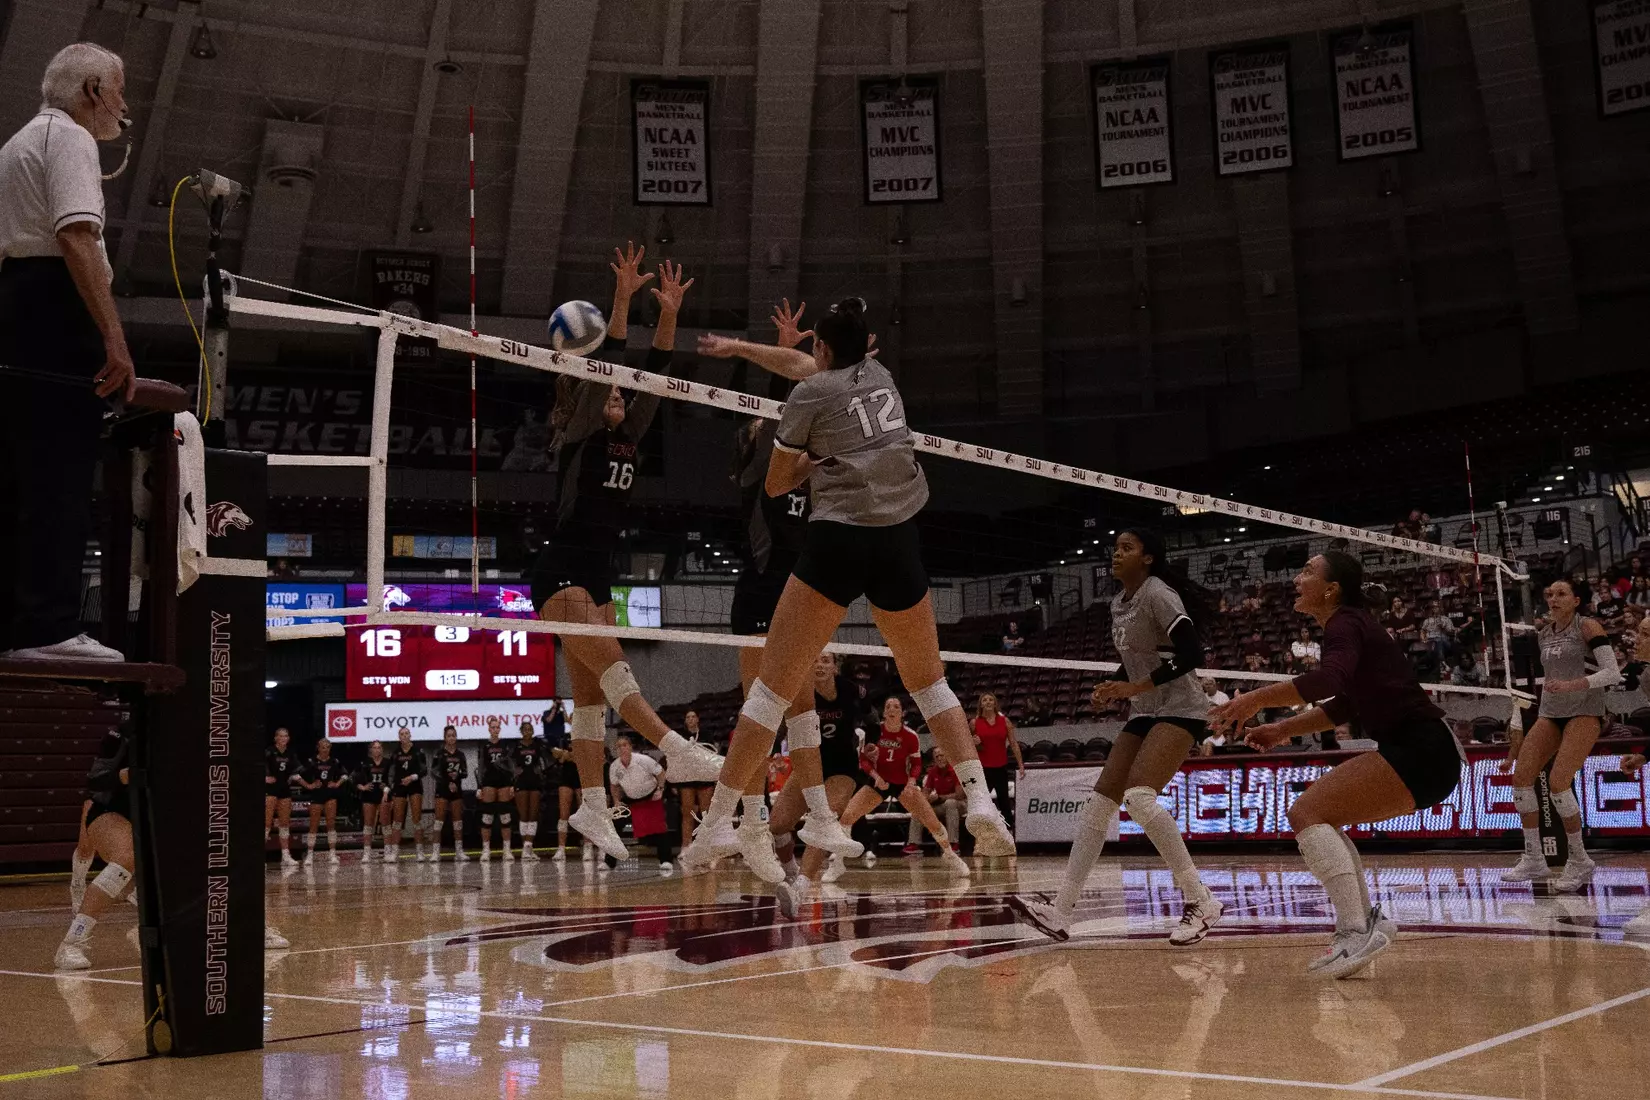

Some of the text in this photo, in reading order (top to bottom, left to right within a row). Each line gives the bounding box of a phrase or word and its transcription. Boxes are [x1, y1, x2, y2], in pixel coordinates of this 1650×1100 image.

[1614, 24, 1650, 47] MV
[1346, 73, 1403, 98] NCAA
[1231, 93, 1271, 114] MVC
[1343, 93, 1410, 111] TOURNAMENT
[868, 110, 932, 119] BASKETBALL
[1105, 107, 1159, 128] NCAA
[1221, 112, 1285, 128] TOURNAMENT
[645, 127, 697, 144] NCAA
[881, 126, 919, 143] MVC
[1101, 127, 1164, 141] TOURNAMENT
[1221, 125, 1287, 143] CHAMPIONS
[1345, 127, 1411, 149] 2005
[652, 147, 690, 158] SWEET
[870, 145, 933, 157] CHAMPIONS
[1223, 144, 1287, 164] 2006
[647, 161, 696, 171] SIXTEEN
[1104, 159, 1167, 177] 2006
[642, 180, 702, 193] 2007
[873, 177, 933, 192] 2007
[846, 387, 905, 439] 12
[500, 340, 529, 357] SIU
[587, 360, 613, 376] SIU
[667, 378, 690, 393] SIU
[738, 395, 760, 410] SIU
[924, 436, 942, 449] SIU
[976, 448, 993, 460] SIU
[1026, 458, 1041, 470] SIU
[1072, 469, 1086, 480] SIU
[1114, 478, 1128, 489] SIU
[1154, 487, 1167, 497] SIU
[1192, 495, 1205, 505] SIU
[1228, 502, 1239, 512] SIU
[1261, 510, 1272, 519] SIU
[1292, 517, 1302, 525] SIU
[1322, 523, 1332, 531] SIU
[1350, 528, 1359, 536] SIU
[1574, 446, 1590, 457] 216
[603, 461, 634, 490] 16
[1546, 511, 1560, 521] 116
[271, 592, 299, 604] STOP
[445, 626, 457, 640] 3
[360, 629, 401, 657] 16
[497, 630, 528, 656] 11
[362, 676, 411, 685] SETS WON
[439, 674, 467, 685] 1:15
[493, 675, 540, 684] SETS WON
[383, 685, 392, 698] 1
[513, 683, 522, 696] 1
[364, 714, 542, 729] TOYOTA MARION TOY
[880, 739, 901, 748] SEMO
[525, 755, 533, 765] 3
[886, 749, 895, 762] 1
[279, 762, 287, 771] 5
[402, 761, 409, 770] 4
[447, 763, 461, 772] 24
[321, 770, 329, 780] 6
[371, 773, 383, 783] 11
[1539, 771, 1550, 796] sports
[205, 610, 232, 1016] SOUTHERN ILLINOIS UNIVERSITY
[1028, 799, 1084, 814] Banter
[1541, 797, 1553, 828] imports
